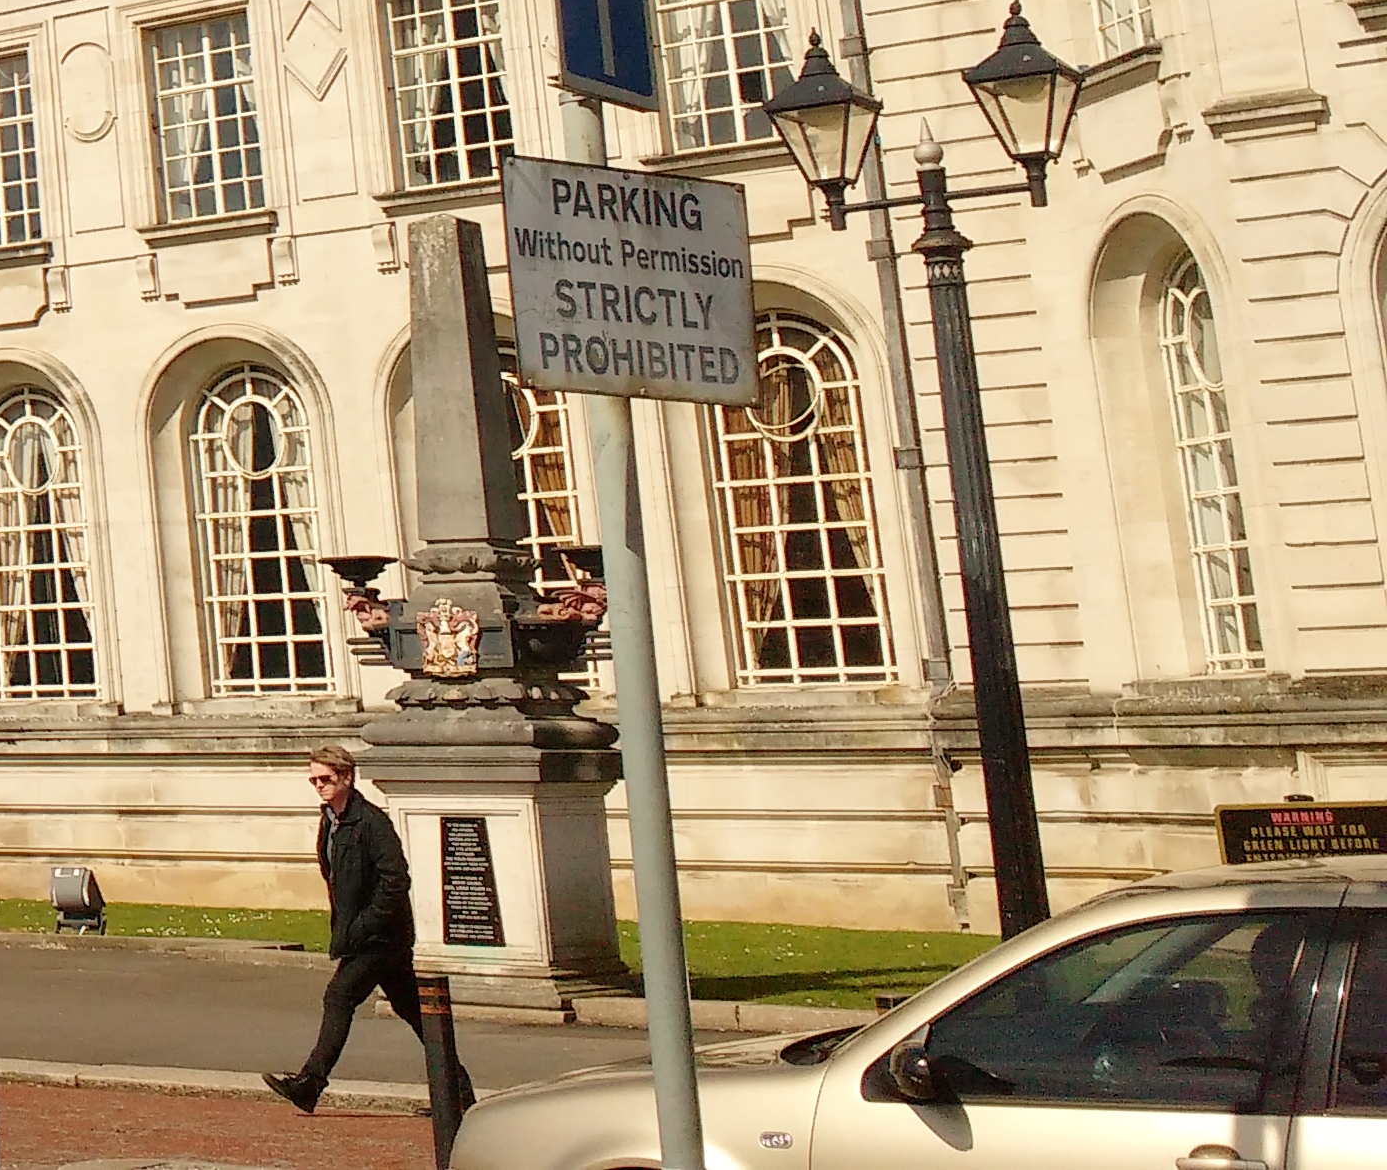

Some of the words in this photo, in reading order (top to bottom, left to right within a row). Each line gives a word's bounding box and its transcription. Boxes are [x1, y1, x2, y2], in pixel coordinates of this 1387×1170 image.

[551, 178, 703, 231] PARKING
[514, 227, 613, 267] Without
[620, 239, 744, 279] Permission
[555, 279, 713, 330] STRICTLY
[538, 331, 740, 385] PROHIBITED
[1250, 826, 1298, 838] PLEASE
[1302, 825, 1336, 837] WAIT
[1341, 824, 1366, 836] FOR
[1270, 811, 1335, 824] WARNING
[1243, 839, 1284, 851] GREEN
[1289, 838, 1326, 850] LIGHT
[1330, 837, 1380, 850] BEFORE
